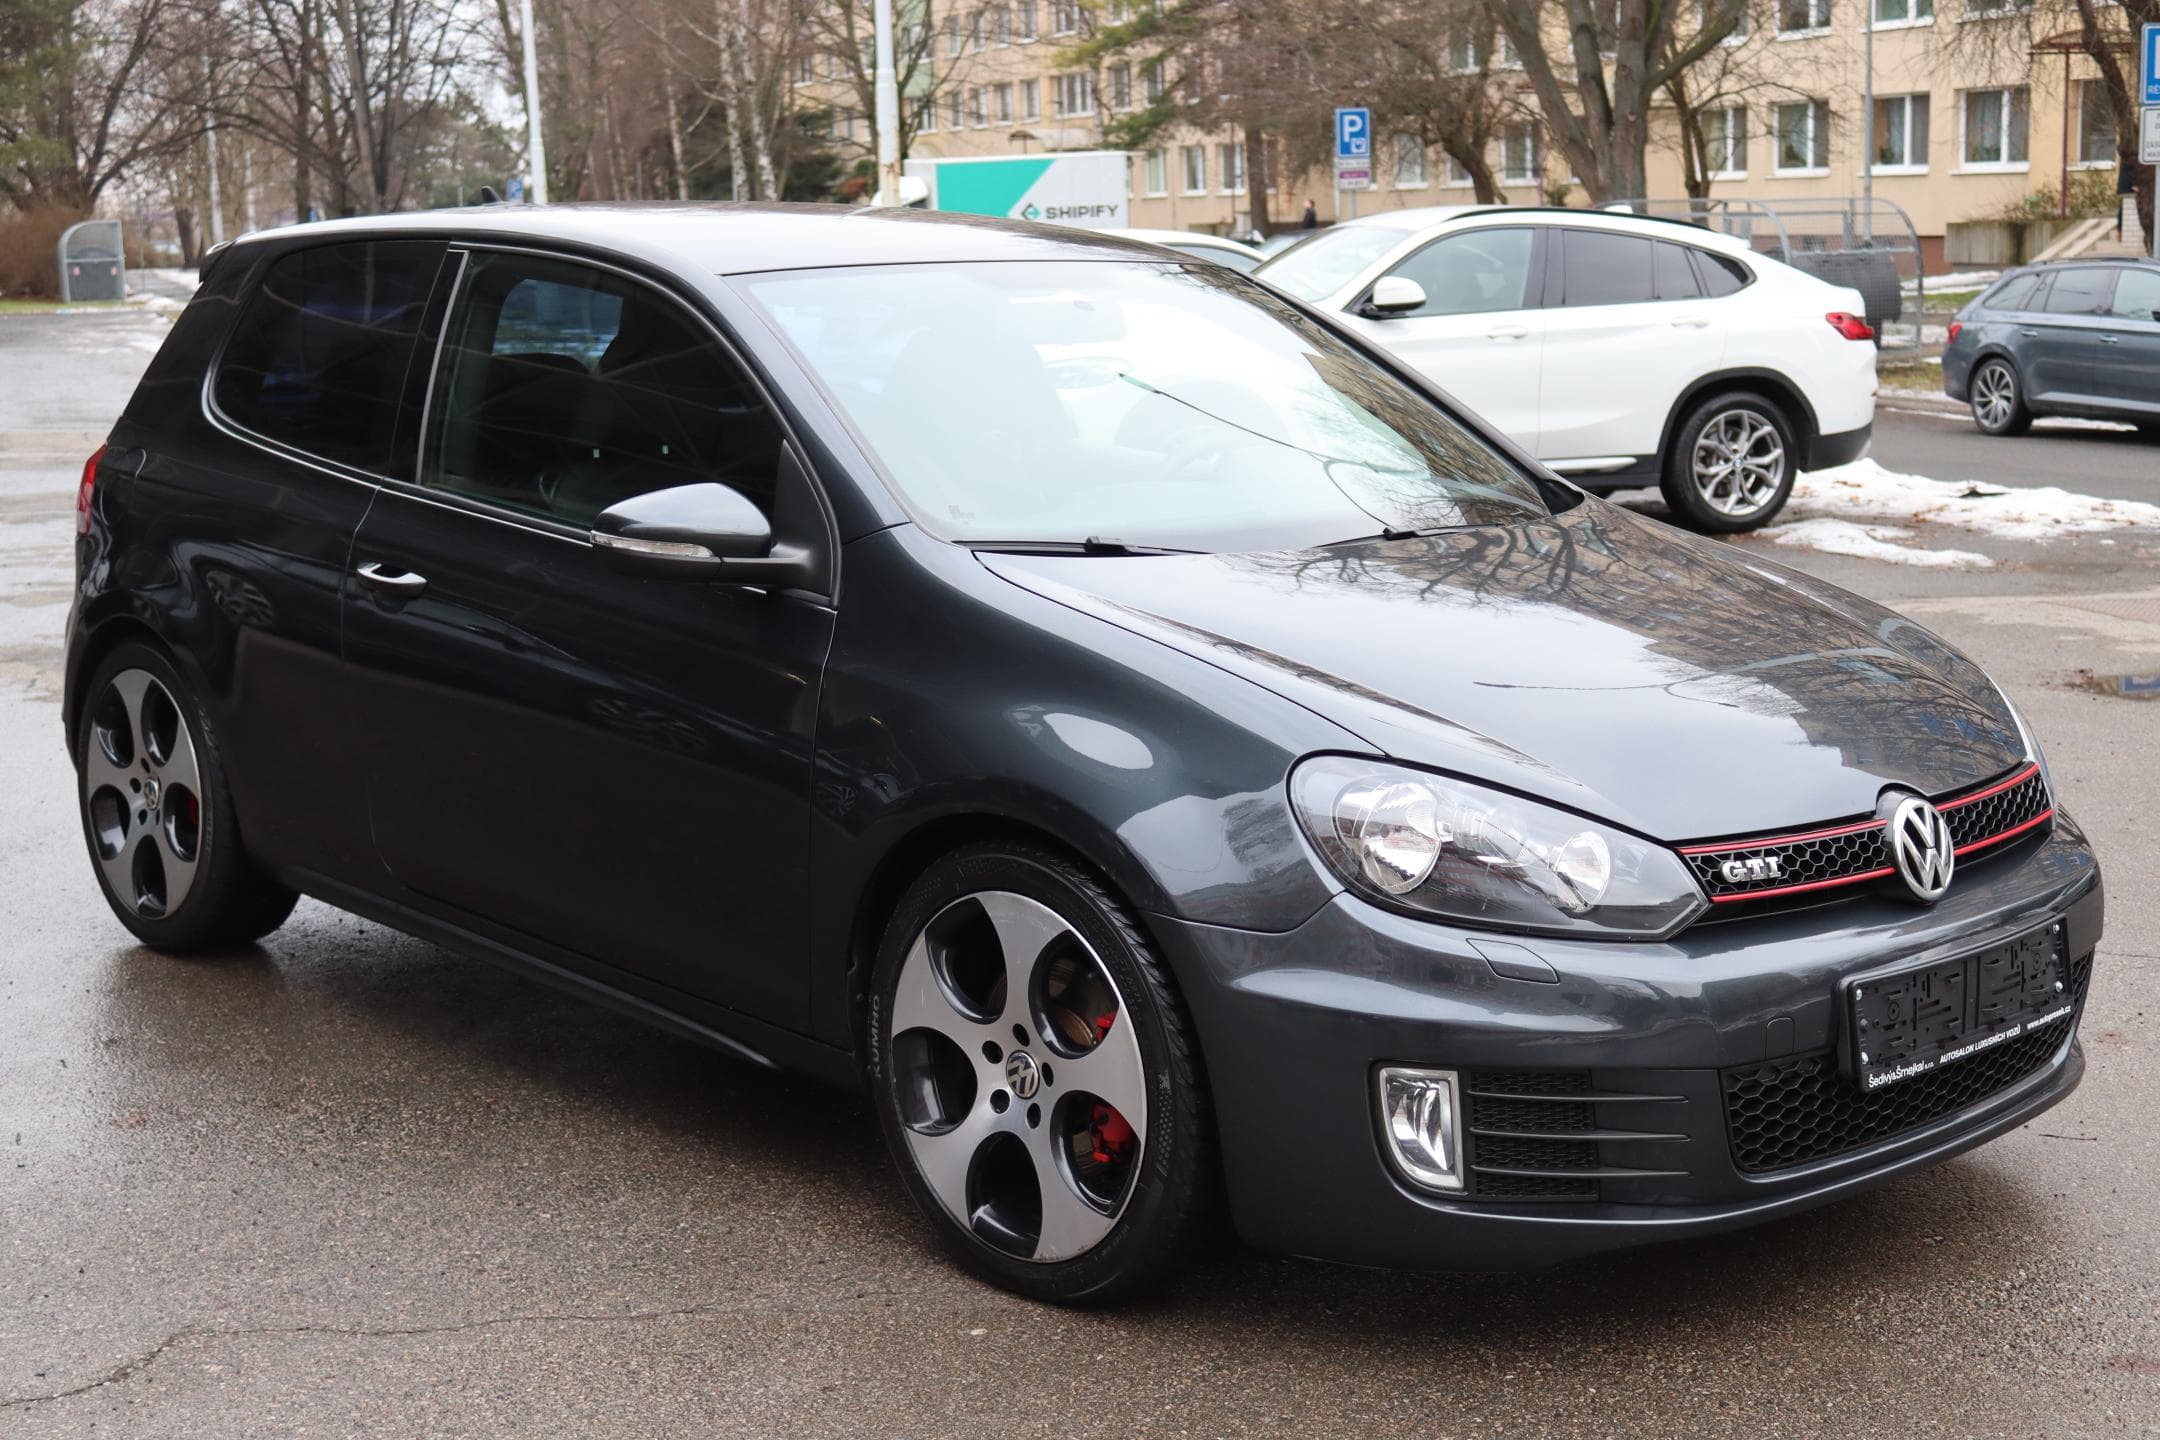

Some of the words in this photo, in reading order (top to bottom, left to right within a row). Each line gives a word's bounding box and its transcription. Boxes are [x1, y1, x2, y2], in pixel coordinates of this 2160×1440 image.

[1343, 114, 1363, 142] P
[1045, 204, 1118, 219] SHIPIFY
[1722, 856, 1781, 883] GTI
[871, 994, 881, 1078] KUMHO
[1940, 1043, 1975, 1064] AUTOSALON
[1974, 1031, 2006, 1051] LUXUSNÍCH
